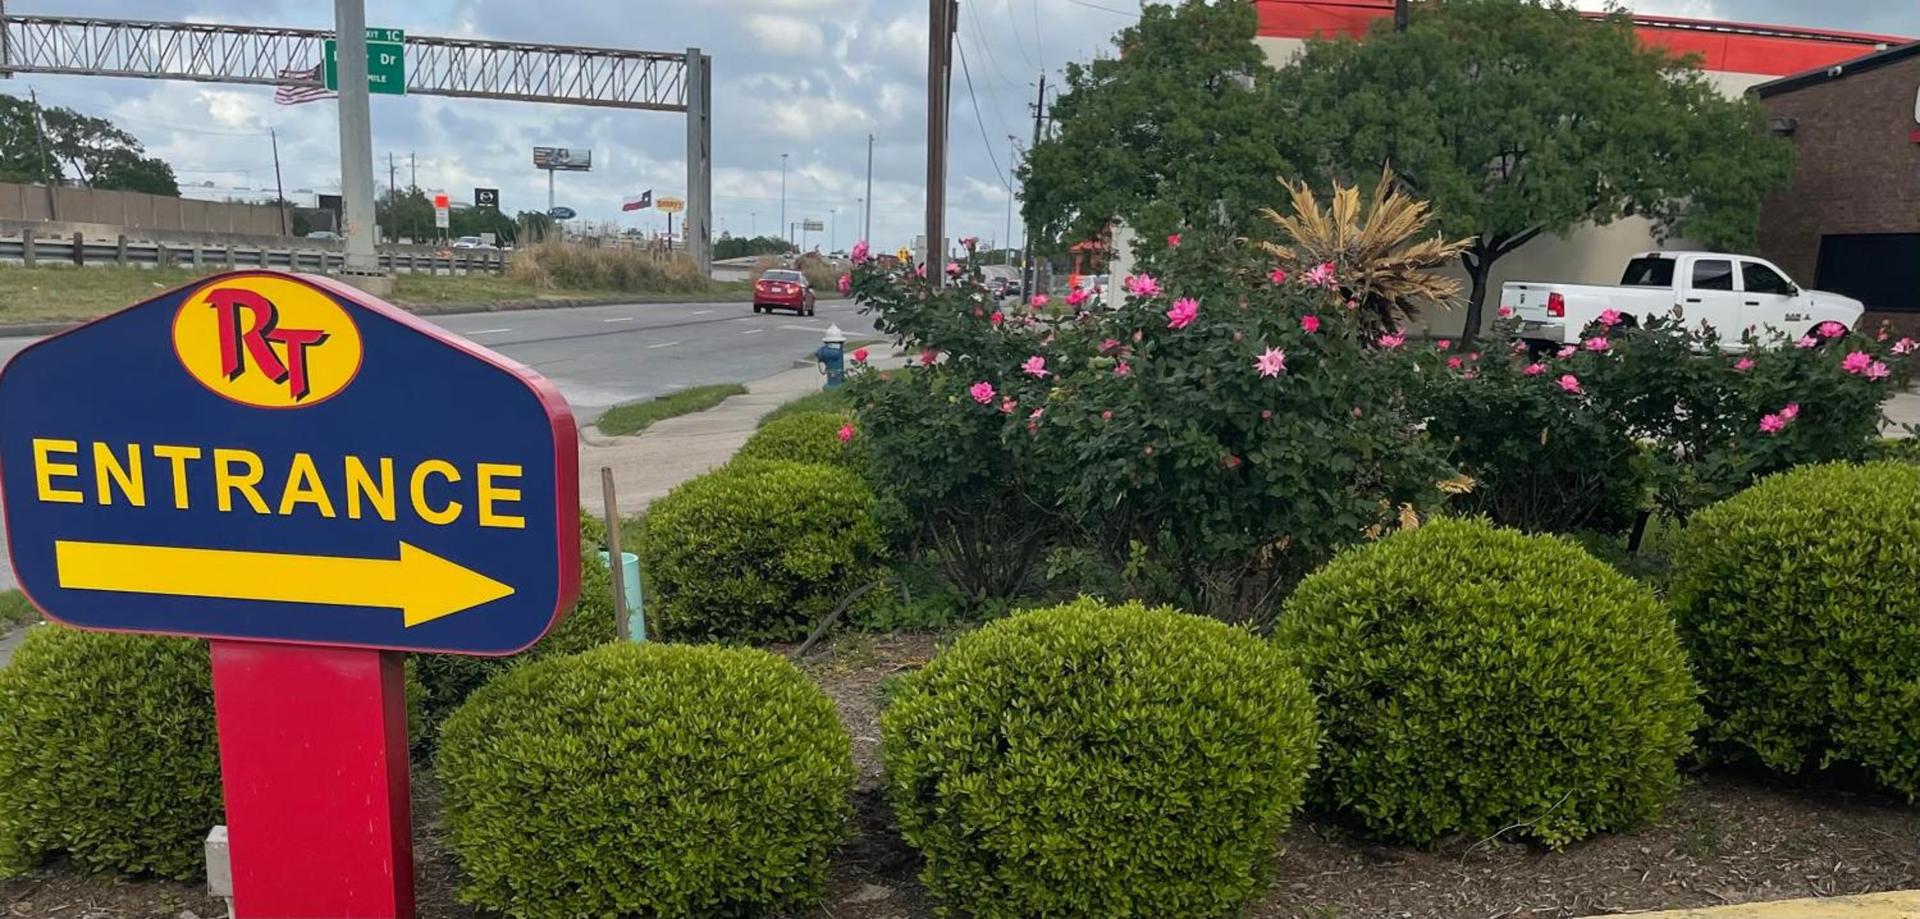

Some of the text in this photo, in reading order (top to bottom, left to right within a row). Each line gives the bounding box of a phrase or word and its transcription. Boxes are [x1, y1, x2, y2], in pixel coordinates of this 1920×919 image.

[365, 30, 400, 41] XIT 1C
[380, 53, 396, 65] Dr
[367, 74, 387, 83] MILE
[203, 287, 331, 403] RT
[32, 438, 526, 529] ENTRANCE
